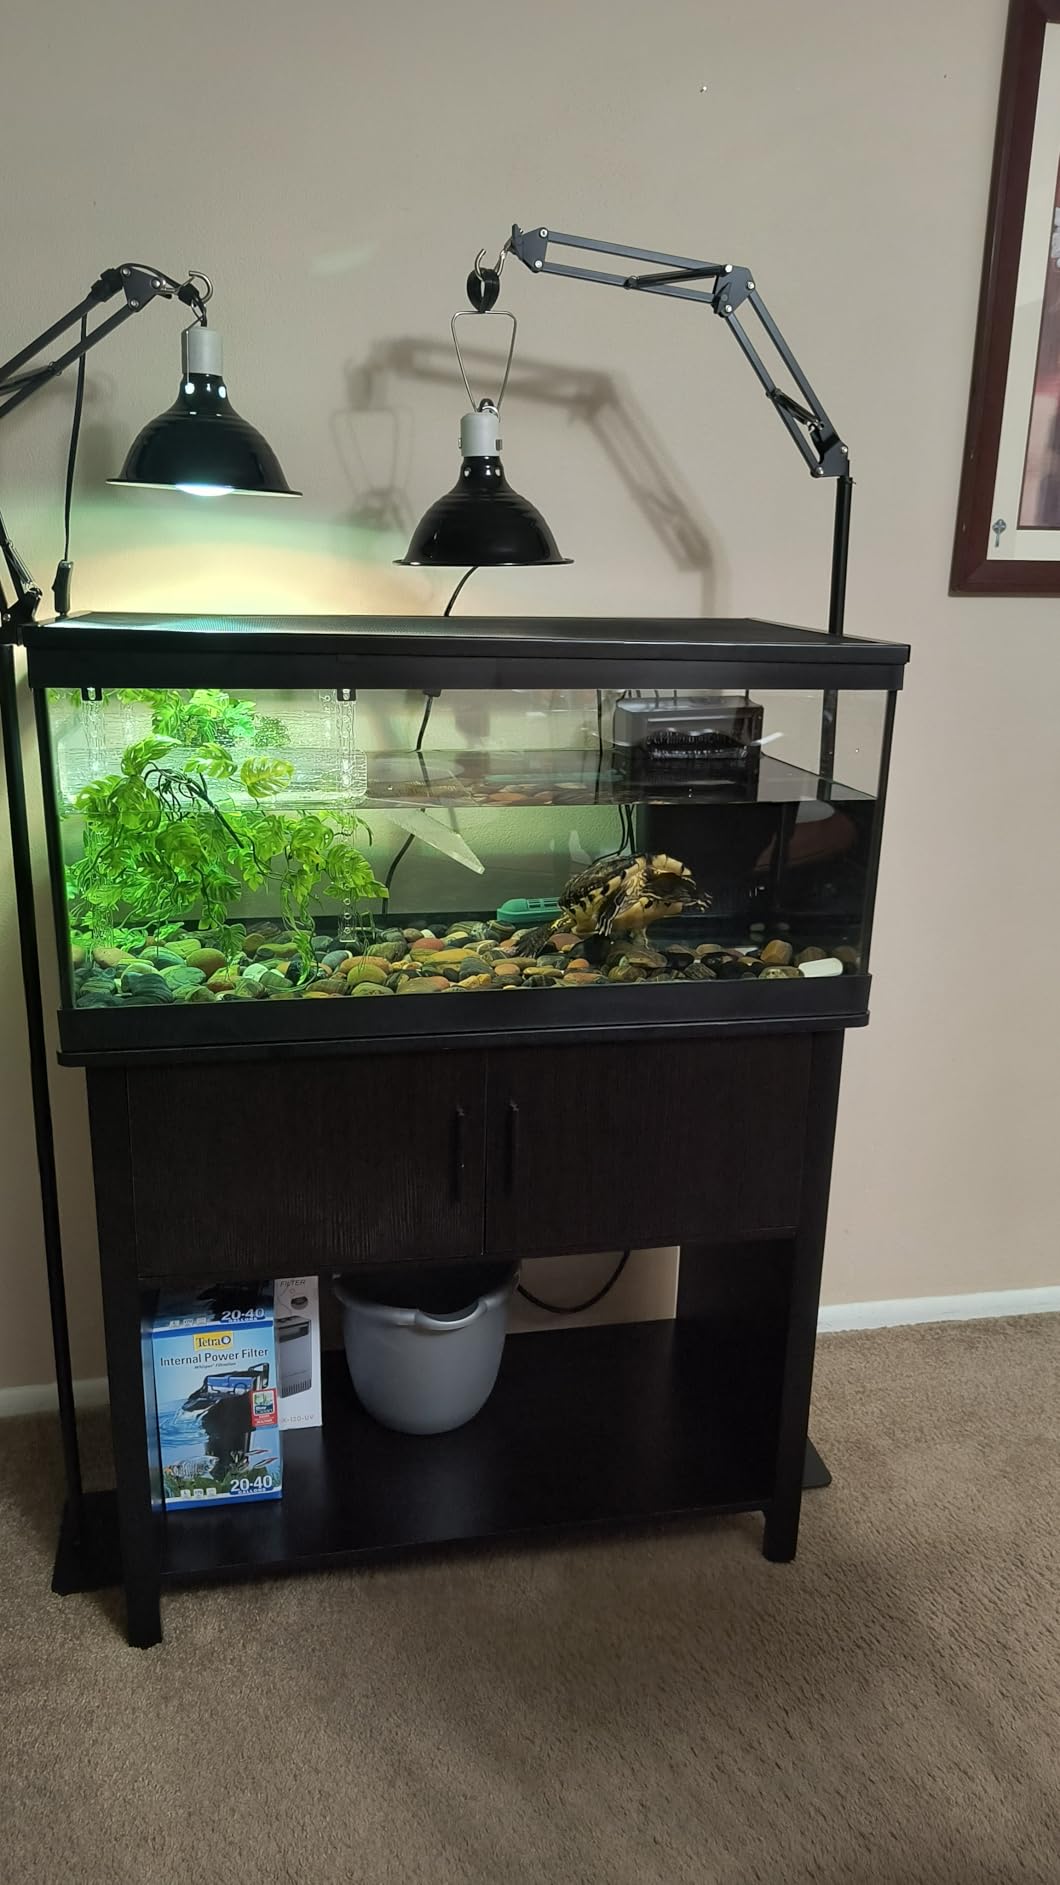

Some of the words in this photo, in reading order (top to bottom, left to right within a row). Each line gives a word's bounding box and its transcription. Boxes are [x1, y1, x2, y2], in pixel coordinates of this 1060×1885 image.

[221, 1308, 265, 1321] 20-40
[160, 1353, 201, 1367] Internal
[205, 1350, 239, 1363] Power
[242, 1348, 269, 1358] Filter
[230, 1476, 273, 1492] 20-40
